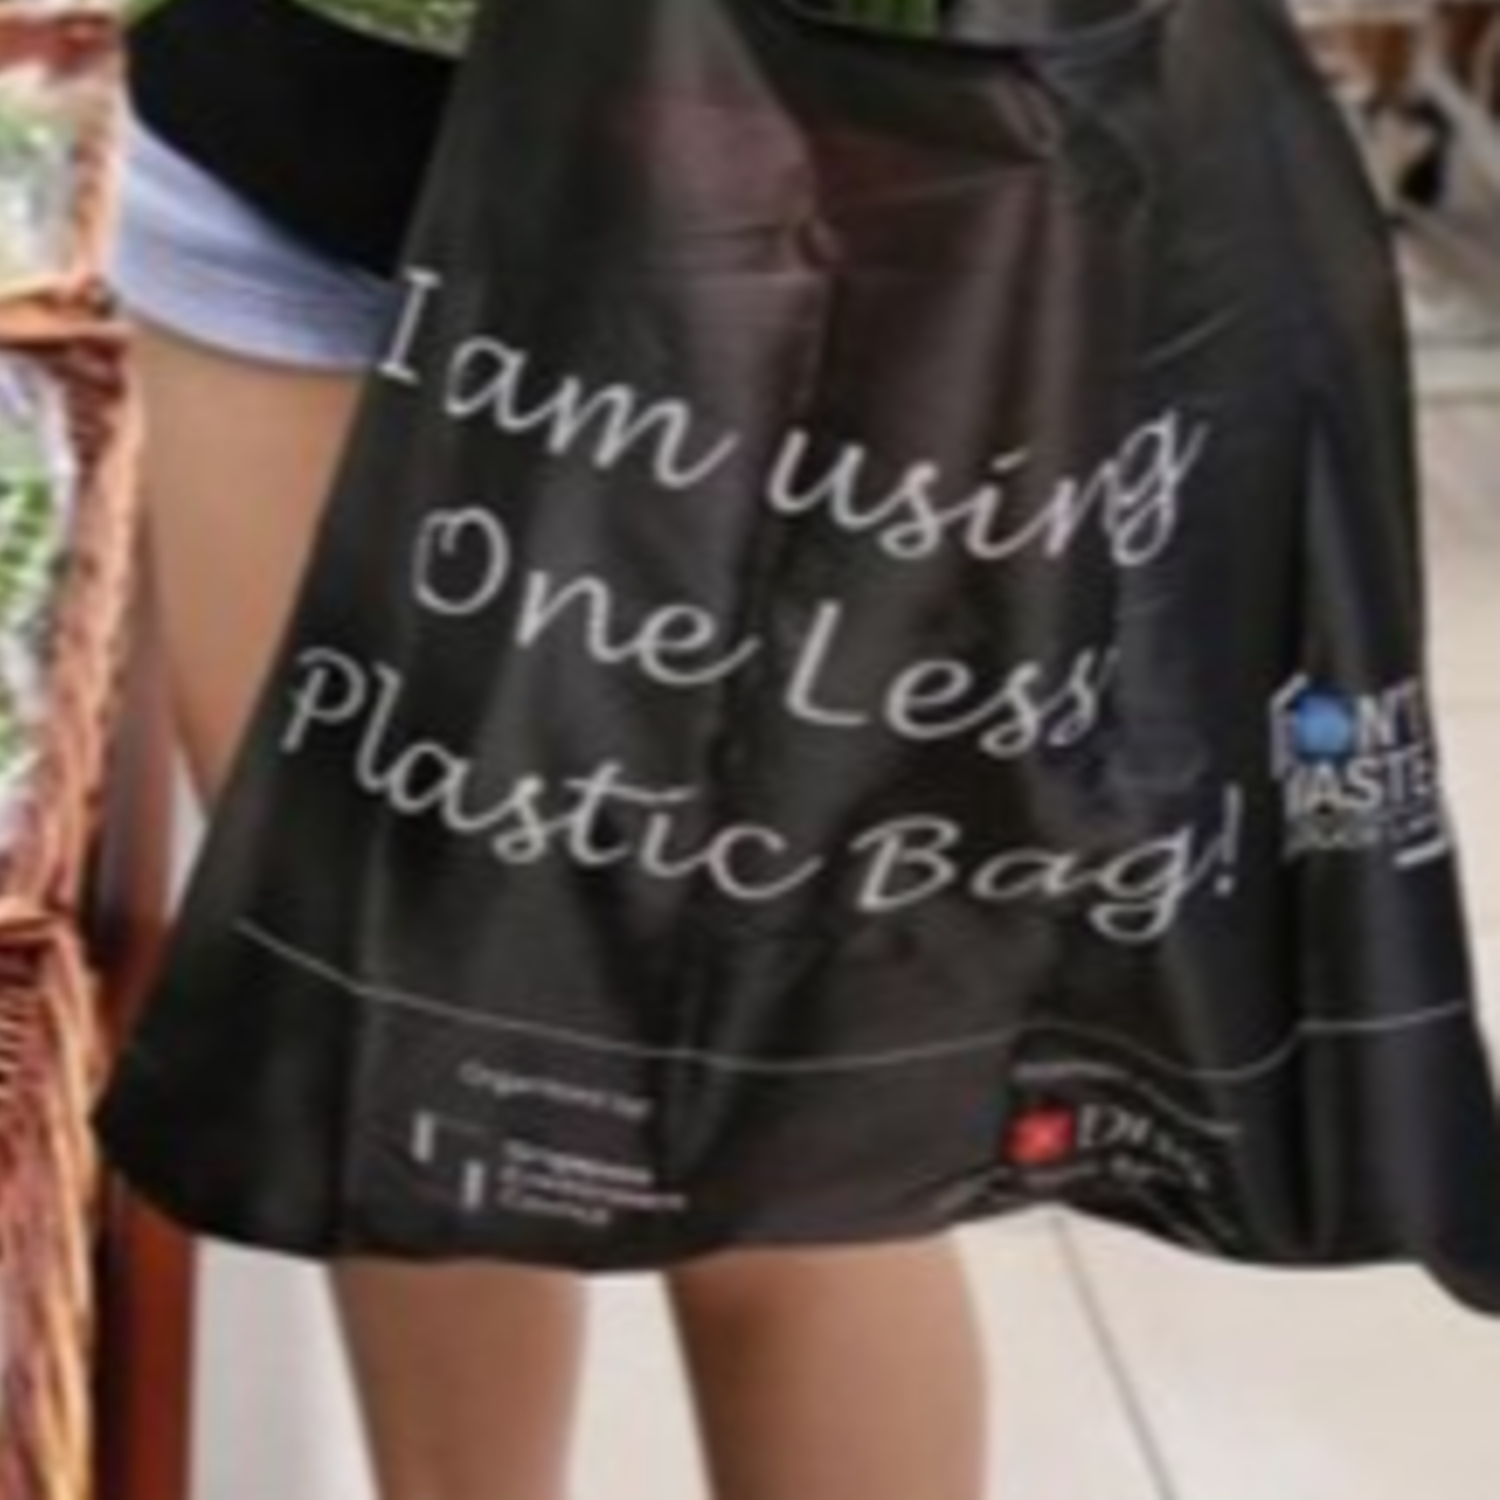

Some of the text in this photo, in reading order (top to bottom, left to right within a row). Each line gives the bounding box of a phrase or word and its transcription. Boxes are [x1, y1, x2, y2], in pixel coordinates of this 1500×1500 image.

[378, 266, 1210, 567] I am using
[410, 505, 1118, 759] One Less
[281, 646, 1242, 943] Plastic Bag!
